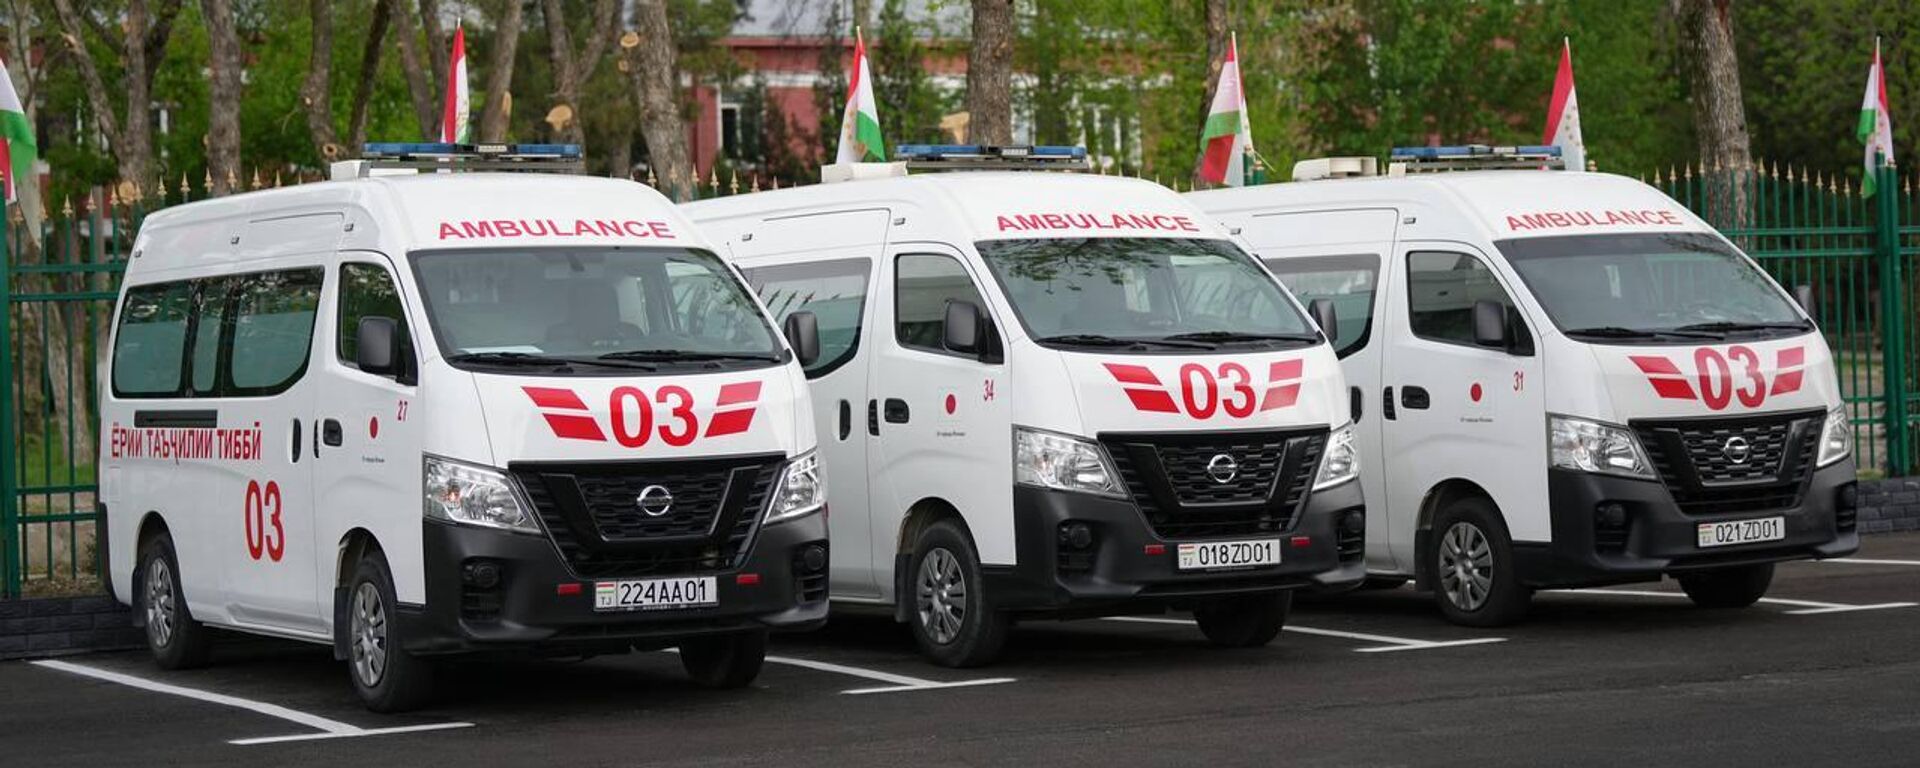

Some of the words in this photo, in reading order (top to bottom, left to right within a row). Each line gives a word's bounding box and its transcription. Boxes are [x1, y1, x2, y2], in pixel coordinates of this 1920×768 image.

[439, 219, 676, 240] AMBULANCE
[996, 213, 1200, 232] AMBULANCE
[1506, 210, 1683, 231] AMBULANCE
[983, 379, 994, 401] 34
[1513, 371, 1524, 391] 31
[1693, 345, 1767, 411] 03
[1180, 362, 1256, 420] 03
[397, 400, 408, 421] 27
[609, 385, 699, 448] 03
[112, 421, 143, 459] ЁРИИ
[245, 479, 285, 562] 03
[1715, 519, 1778, 543] 021ZD01
[1199, 542, 1272, 566] 018ZD01
[620, 580, 706, 605] 224AA01
